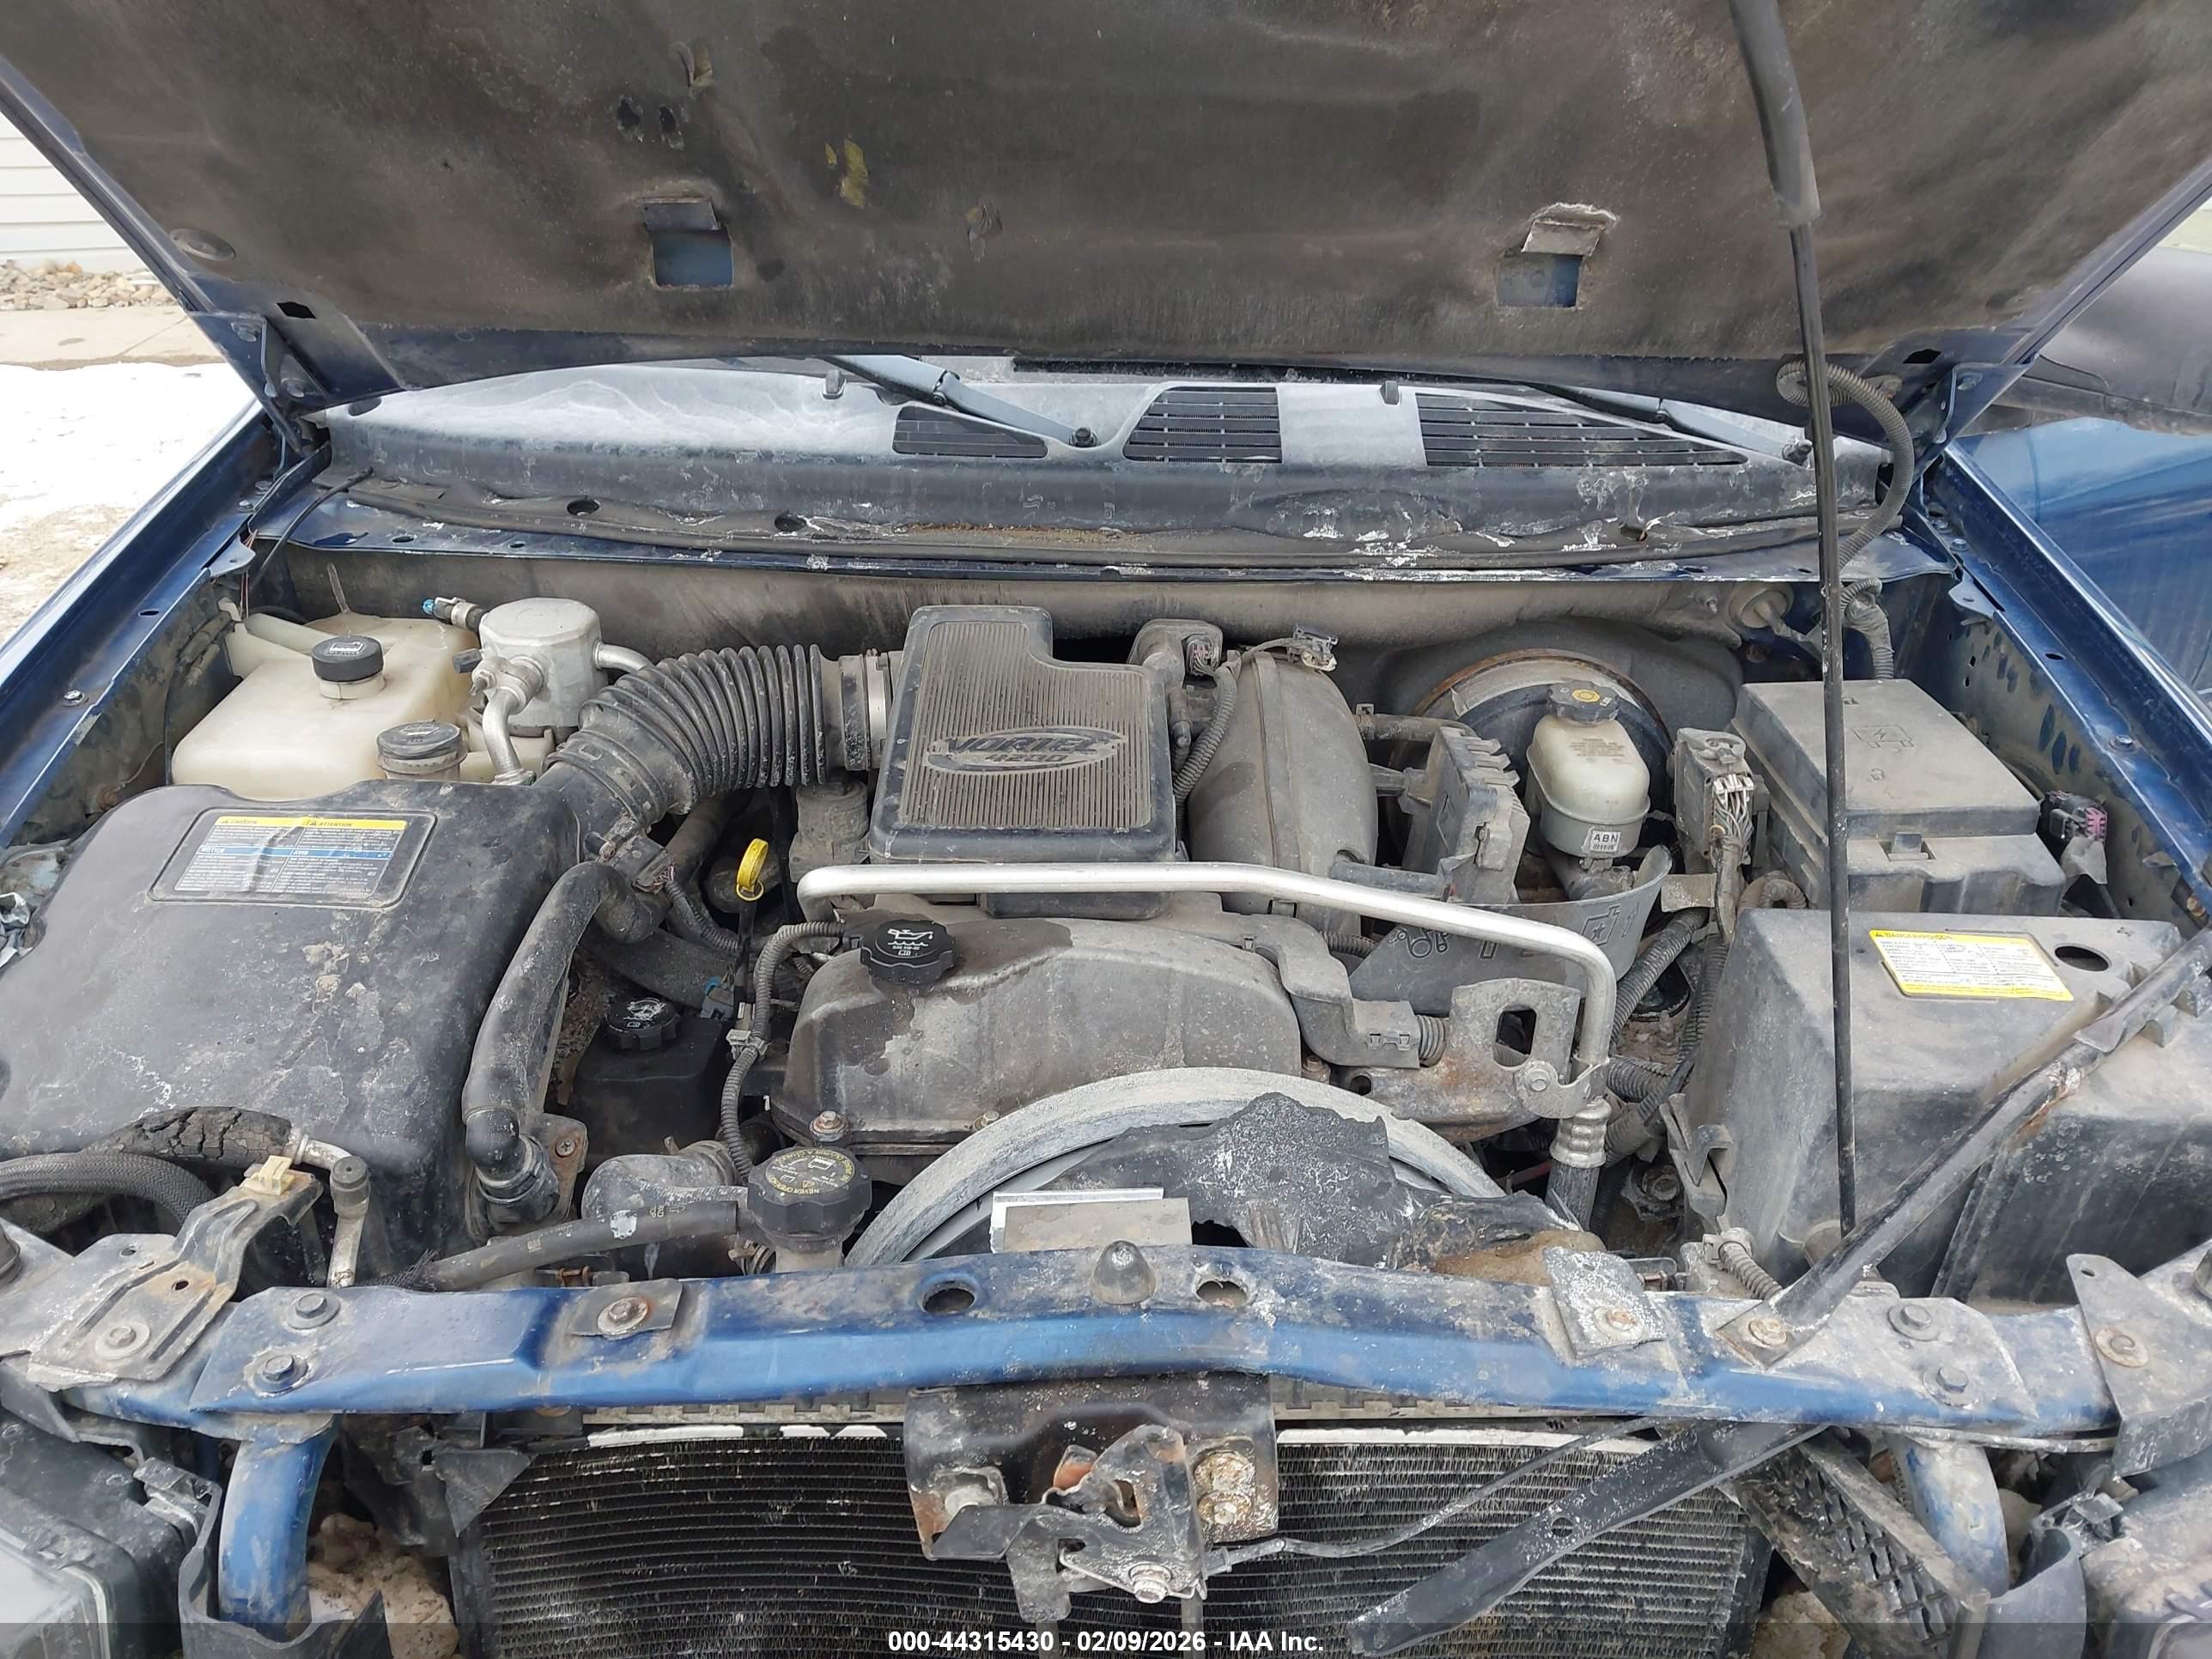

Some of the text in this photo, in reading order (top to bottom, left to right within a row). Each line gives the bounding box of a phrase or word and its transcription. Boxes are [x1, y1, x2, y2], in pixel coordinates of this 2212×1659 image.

[948, 736, 1099, 753] VORTEC
[985, 753, 1067, 763] 4200
[1593, 831, 1620, 842] ABN
